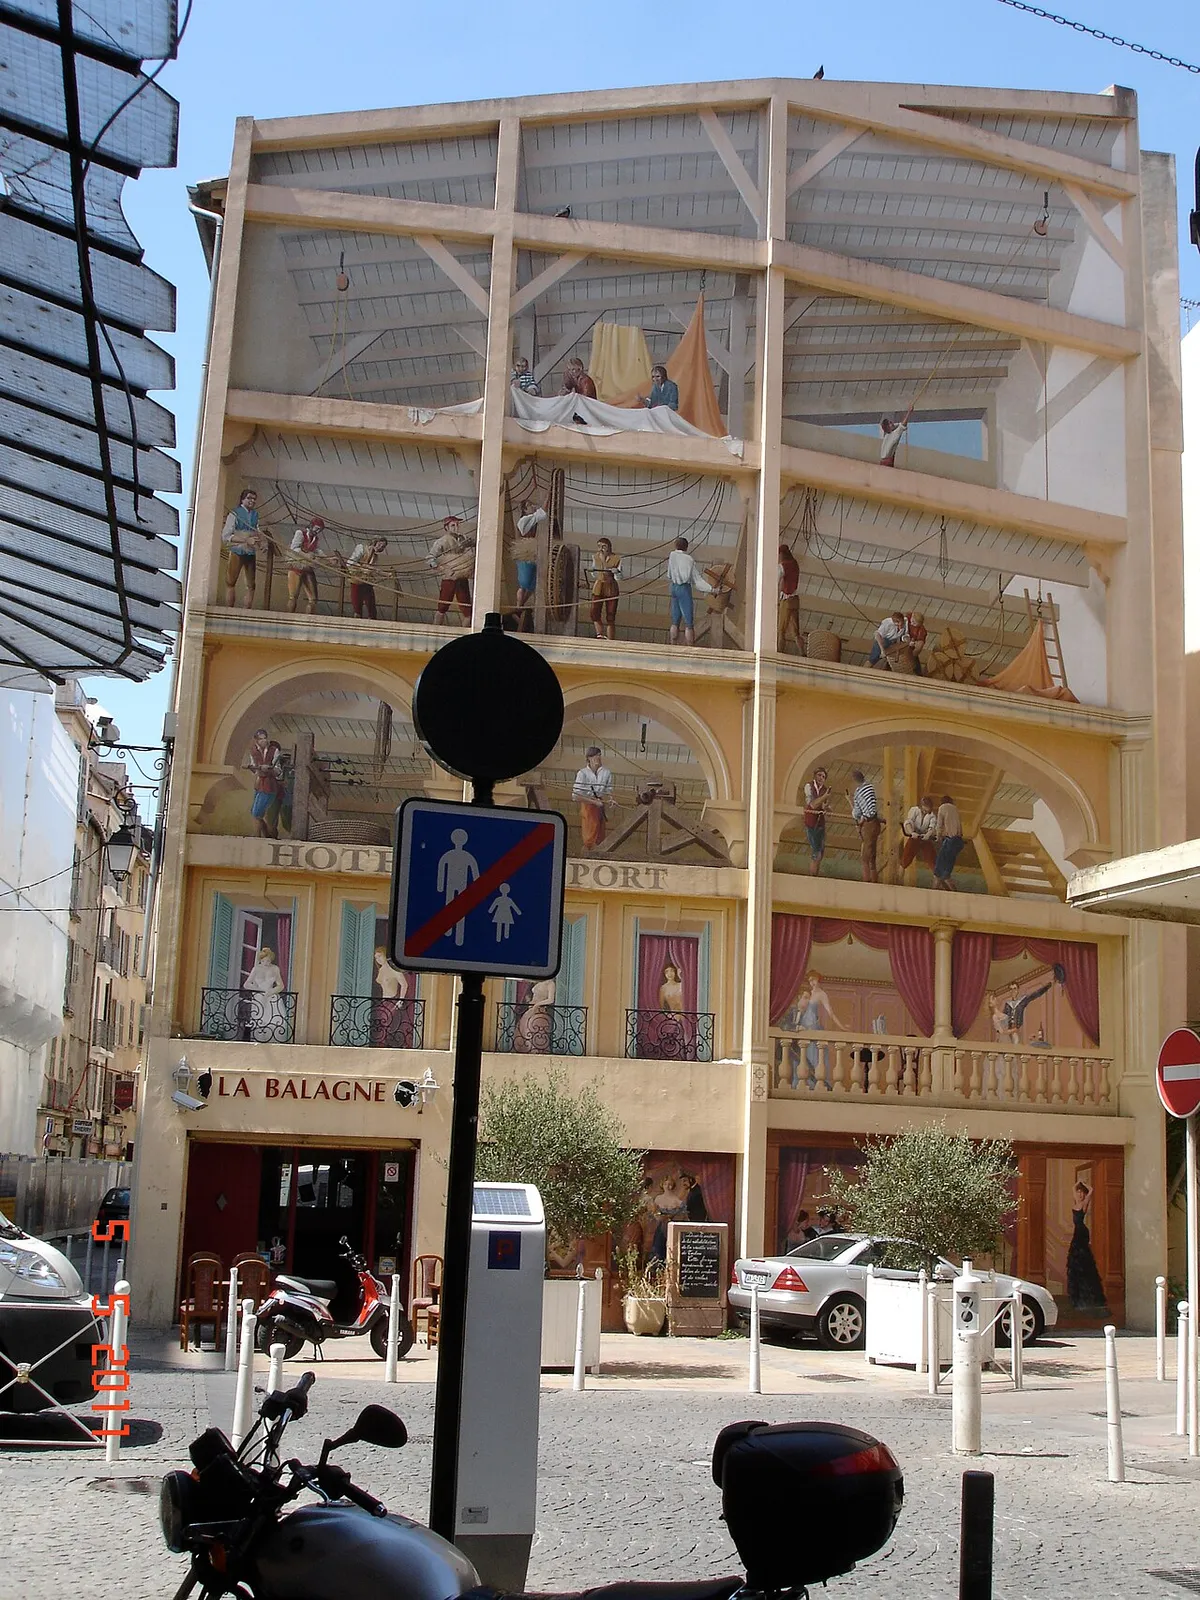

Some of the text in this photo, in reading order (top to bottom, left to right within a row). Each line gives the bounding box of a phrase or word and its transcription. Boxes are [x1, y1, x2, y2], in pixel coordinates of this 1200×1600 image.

[267, 843, 669, 889] HOTE PORT
[218, 1076, 386, 1102] LA BALAGNE
